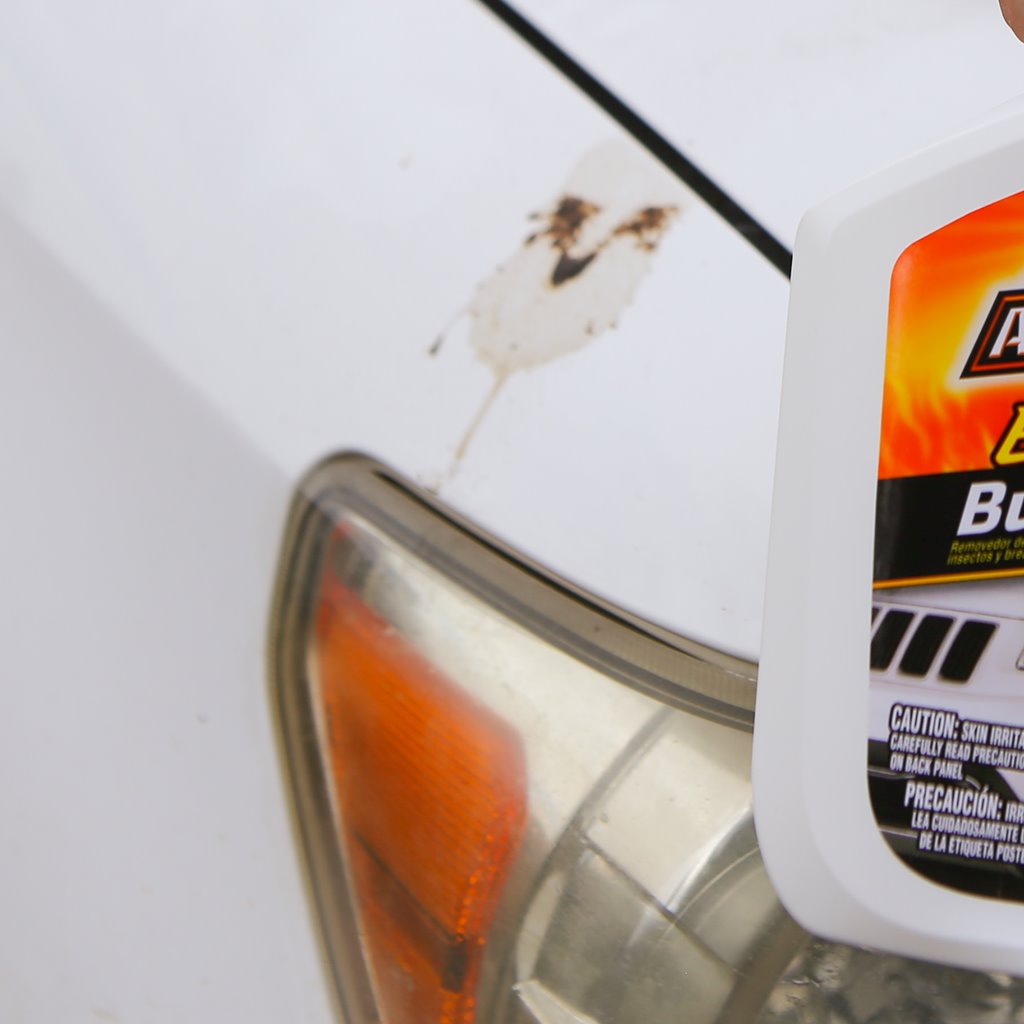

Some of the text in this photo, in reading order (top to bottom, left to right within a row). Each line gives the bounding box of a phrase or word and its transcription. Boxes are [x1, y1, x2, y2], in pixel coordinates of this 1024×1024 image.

[950, 538, 1011, 553] Removedor
[995, 551, 1002, 564] y
[891, 705, 960, 739] CAUTION:
[961, 721, 989, 743] SKIN
[890, 733, 943, 755] CAREFULLY
[944, 741, 971, 761] READ
[890, 754, 963, 780] ON BACK PANEL
[904, 781, 1002, 819] PRECAUCIÓN:
[911, 811, 930, 829] LEA
[931, 814, 1019, 843] CUIDADOSAMENTE
[919, 832, 932, 850] DE
[934, 835, 947, 852] LA
[948, 837, 994, 860] ETIQUETA
